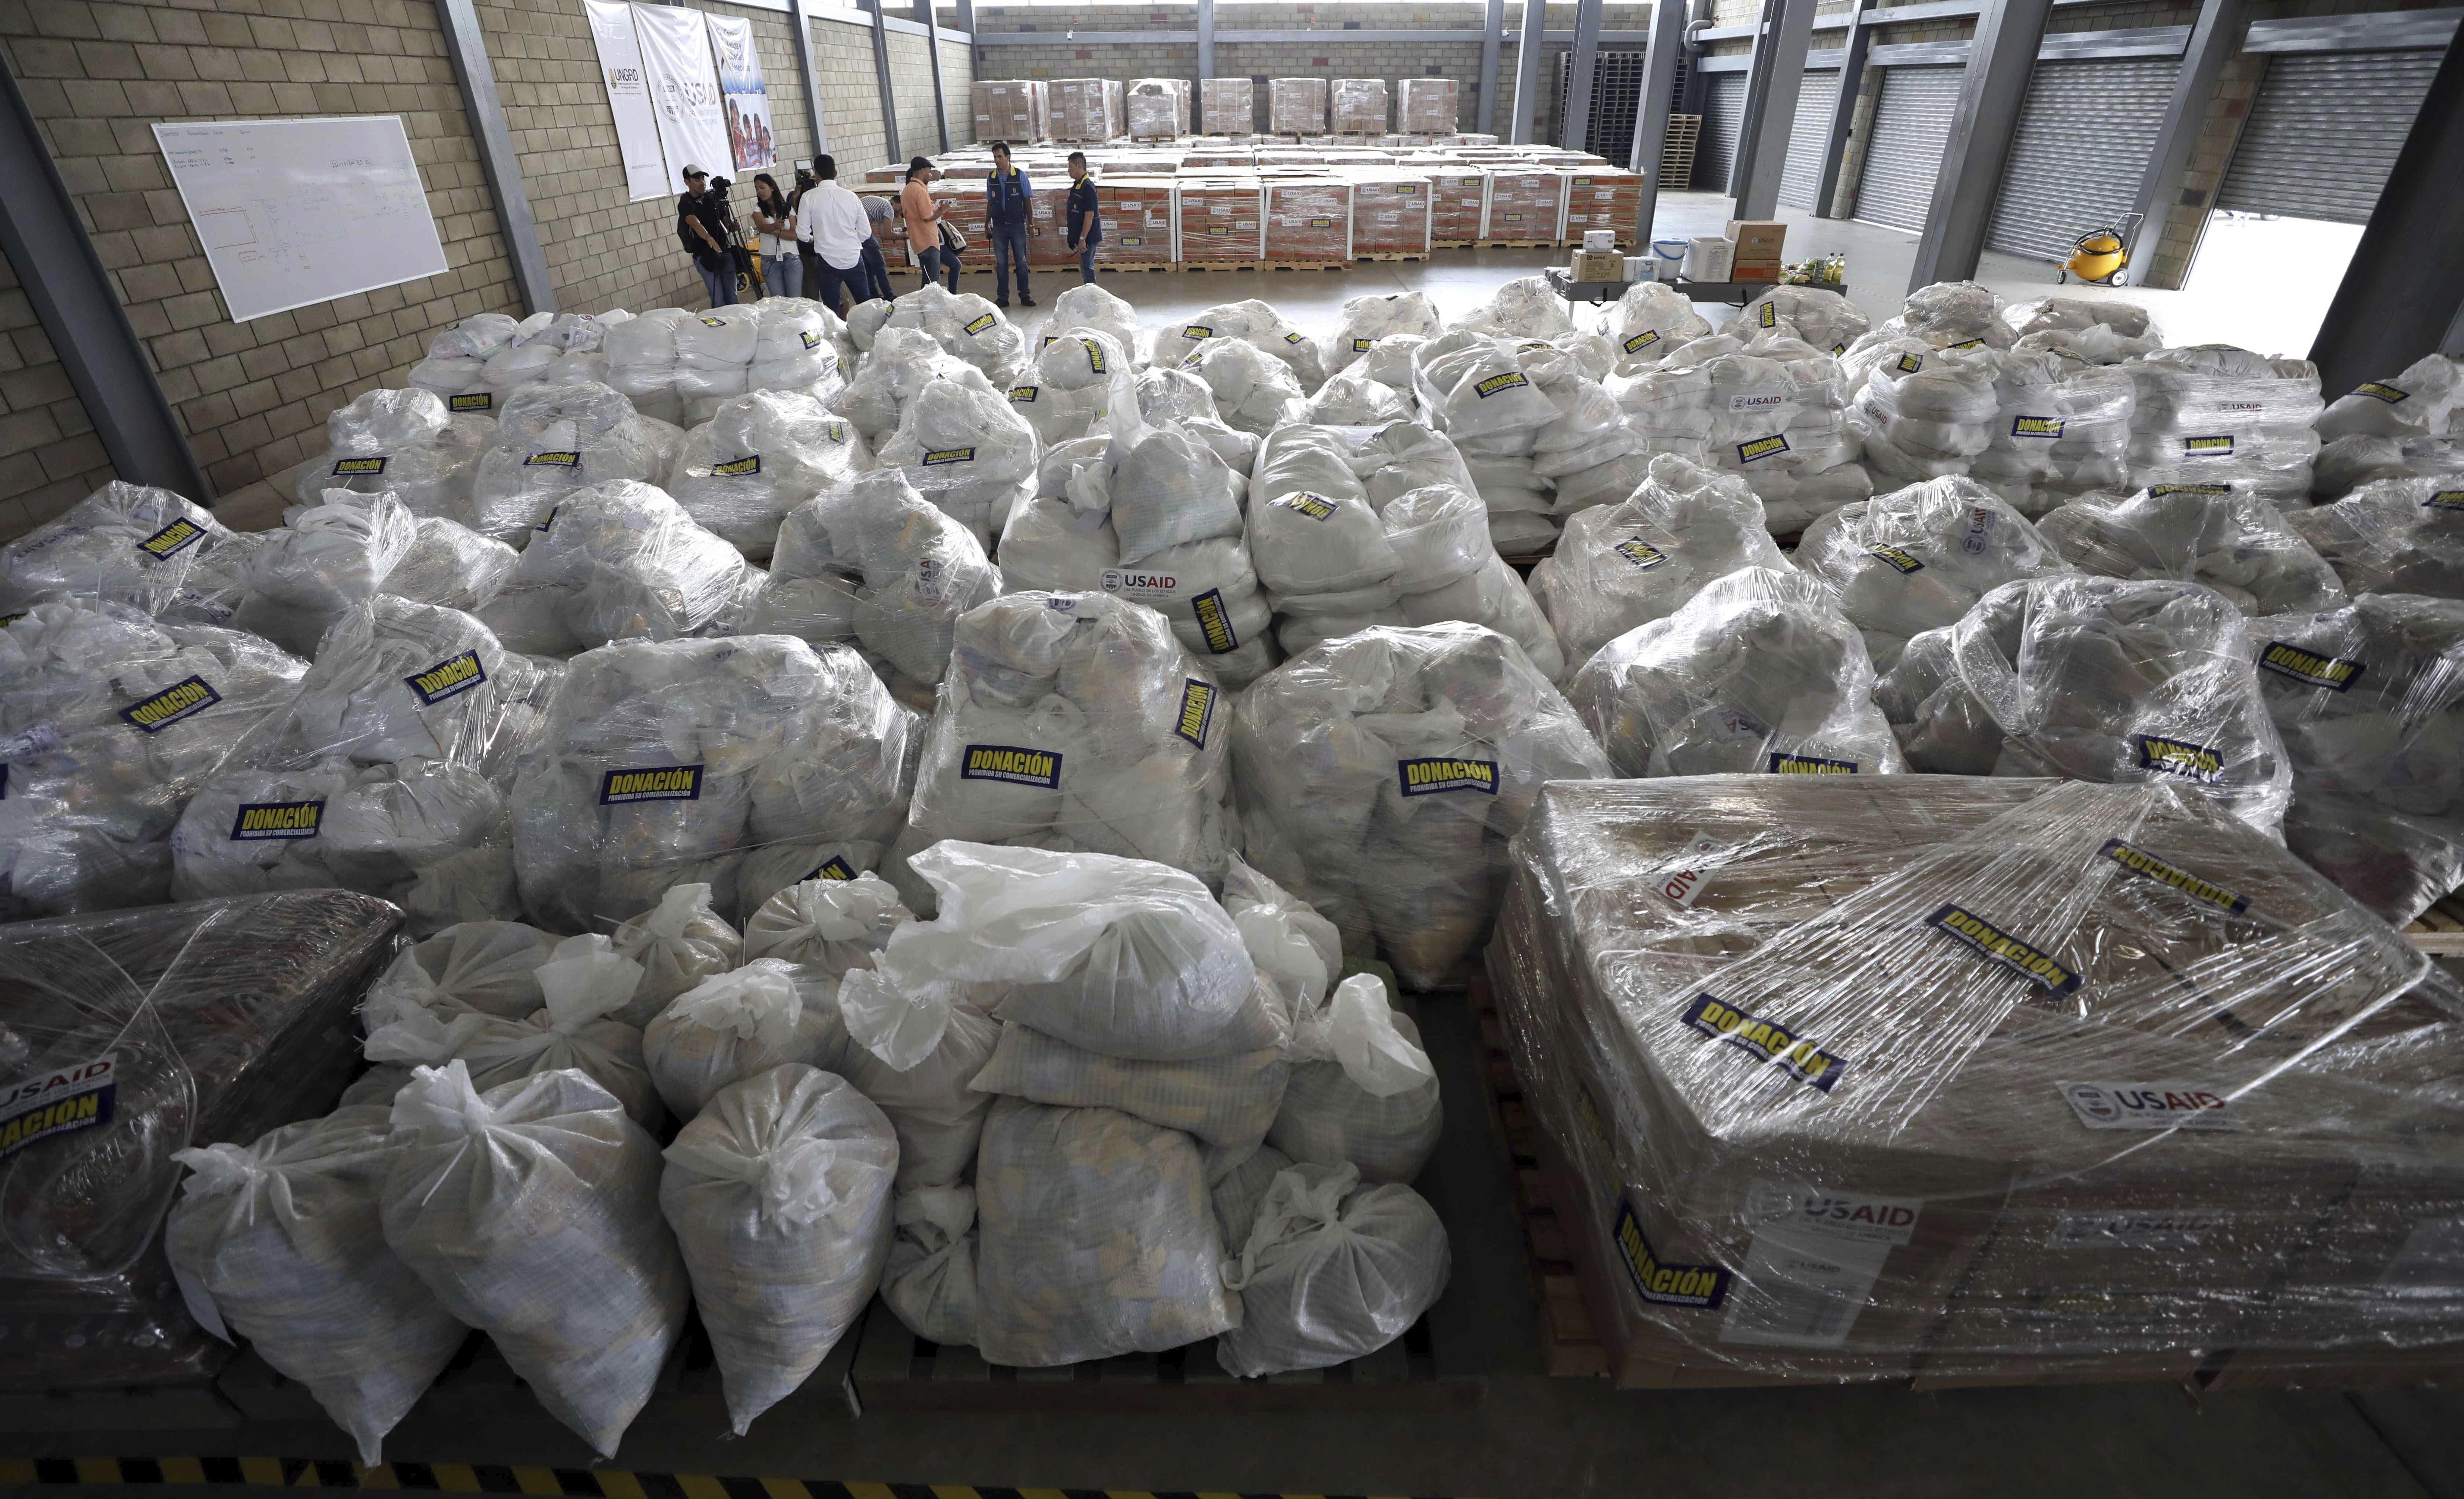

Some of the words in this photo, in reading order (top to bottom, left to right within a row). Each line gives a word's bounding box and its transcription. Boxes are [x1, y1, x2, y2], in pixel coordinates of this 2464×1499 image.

[614, 69, 638, 81] UNGRD
[967, 314, 993, 333] DONACIÓN
[1763, 303, 1774, 326] DONACIÓN
[1186, 328, 1209, 337] DONACIÓN
[1626, 332, 1656, 350] DONACIÓN
[1084, 340, 1102, 370] DONACIÓN
[1479, 373, 1525, 393] DONACIÓN
[453, 394, 488, 407] DONACIÓN
[1747, 396, 1781, 405] USAID
[1871, 407, 1887, 424] USAID
[2017, 419, 2062, 432] DONACIÓN
[1742, 438, 1785, 457] DONACIÓN
[2190, 437, 2230, 449] DONACIÓN
[529, 453, 575, 463] DONACIÓN
[927, 448, 971, 461] DONACIÓN
[338, 459, 382, 471] DONACIÓN
[144, 521, 196, 553] DONACIÓN
[1125, 574, 1176, 588] USAID
[1197, 597, 1229, 651] DONACIÓN
[2266, 646, 2355, 682] DONACIÓN
[415, 656, 478, 694] DONACIÓN
[130, 681, 210, 724] DONACIÓN
[1180, 684, 1208, 739] DONACIÓN
[970, 750, 1053, 777] DONACIÓN
[1407, 762, 1492, 785] DONACIÓN
[609, 768, 694, 794] DONACIÓN
[968, 769, 994, 777] PROHIBIDA
[1002, 772, 1050, 785] COMERCIALIZACIÓN
[608, 793, 634, 801] PROHIBIDA
[1410, 783, 1438, 792] PROHIBIDA
[242, 803, 318, 830] DONACIÓN
[1665, 869, 1698, 900] AID
[1944, 910, 2068, 987] DONACIÓN
[1699, 1002, 1831, 1077] DONACIÓN
[2113, 1090, 2225, 1111] USAID
[1804, 1198, 1914, 1227] USAID
[1621, 1211, 1718, 1297] DONACIÓN
